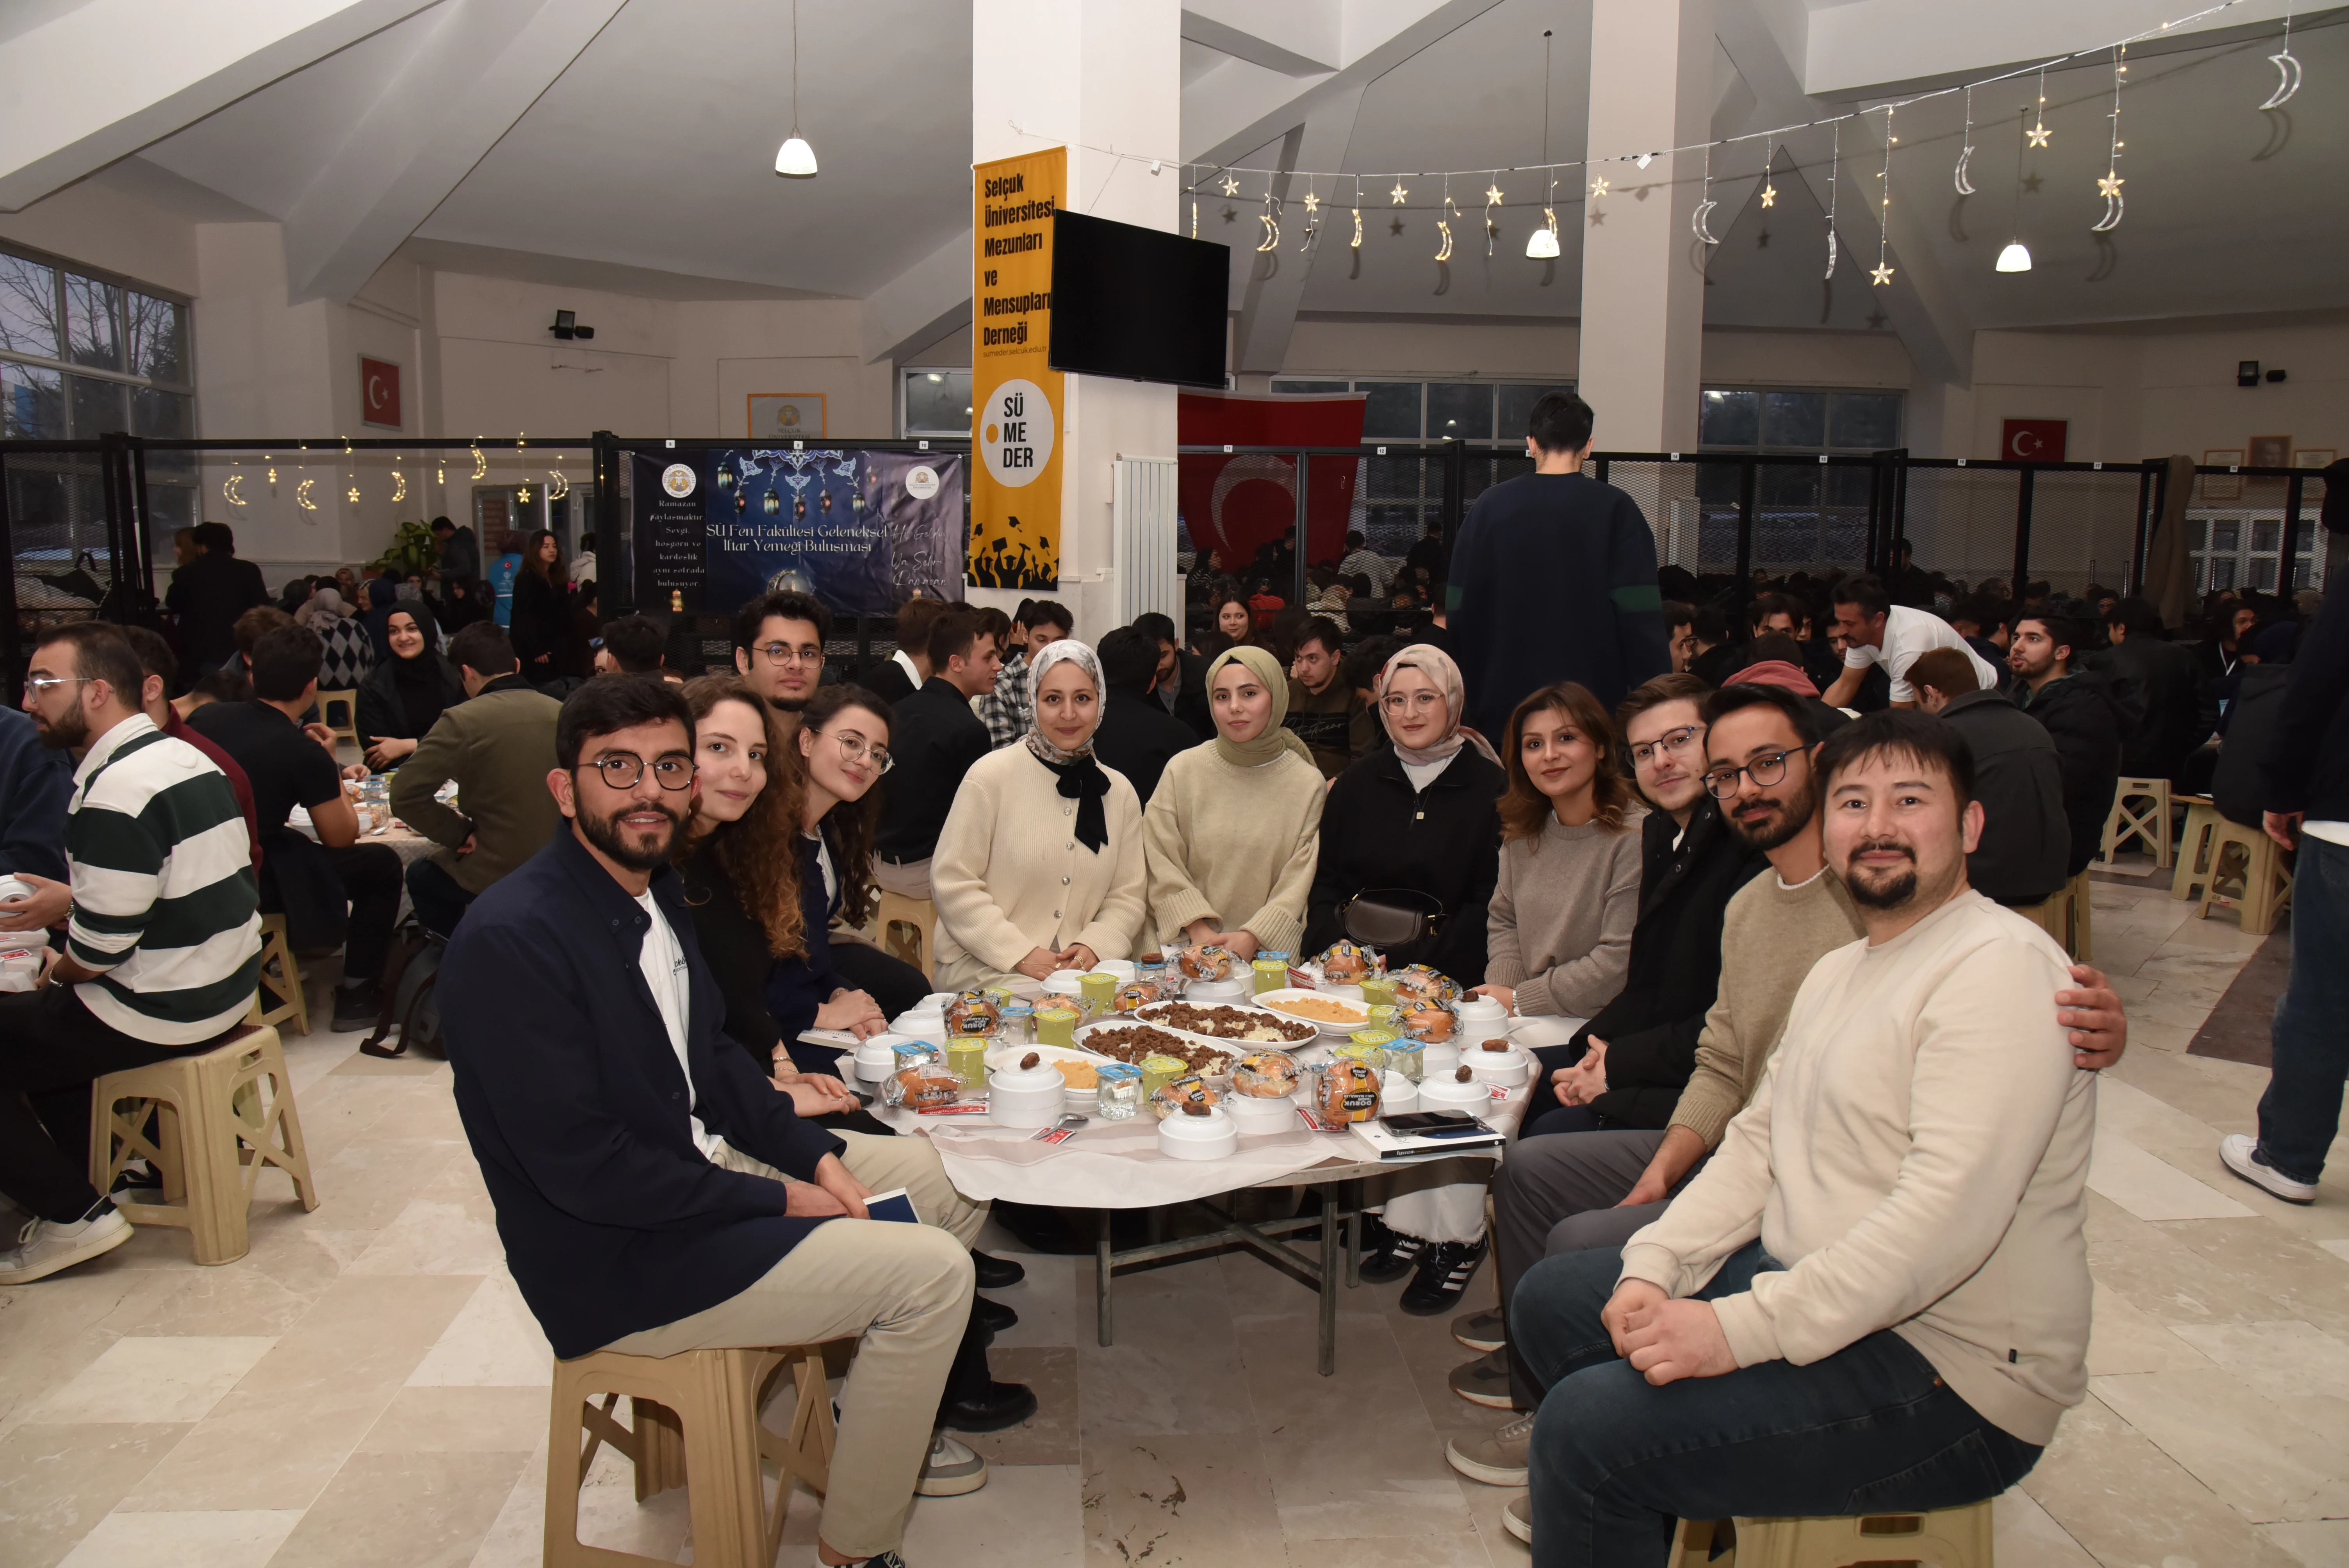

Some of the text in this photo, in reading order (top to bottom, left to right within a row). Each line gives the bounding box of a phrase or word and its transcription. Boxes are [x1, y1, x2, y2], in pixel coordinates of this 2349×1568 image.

[985, 173, 1023, 200] Selçuk
[985, 196, 1055, 228] Üniversitesi
[984, 232, 1042, 258] Mezunları
[984, 269, 997, 287] ve
[984, 292, 1051, 317] Mensupları
[984, 321, 1028, 346] Derneği
[983, 346, 1047, 358] sumeder.selcuk.edu.tr
[1004, 392, 1023, 417] SÜ
[1003, 422, 1027, 442] ME
[1003, 447, 1033, 468] DER
[706, 522, 887, 537] SÜ Fen Fakültesi Geleneksel
[724, 537, 872, 555] İftar Yemeği Buluşması
